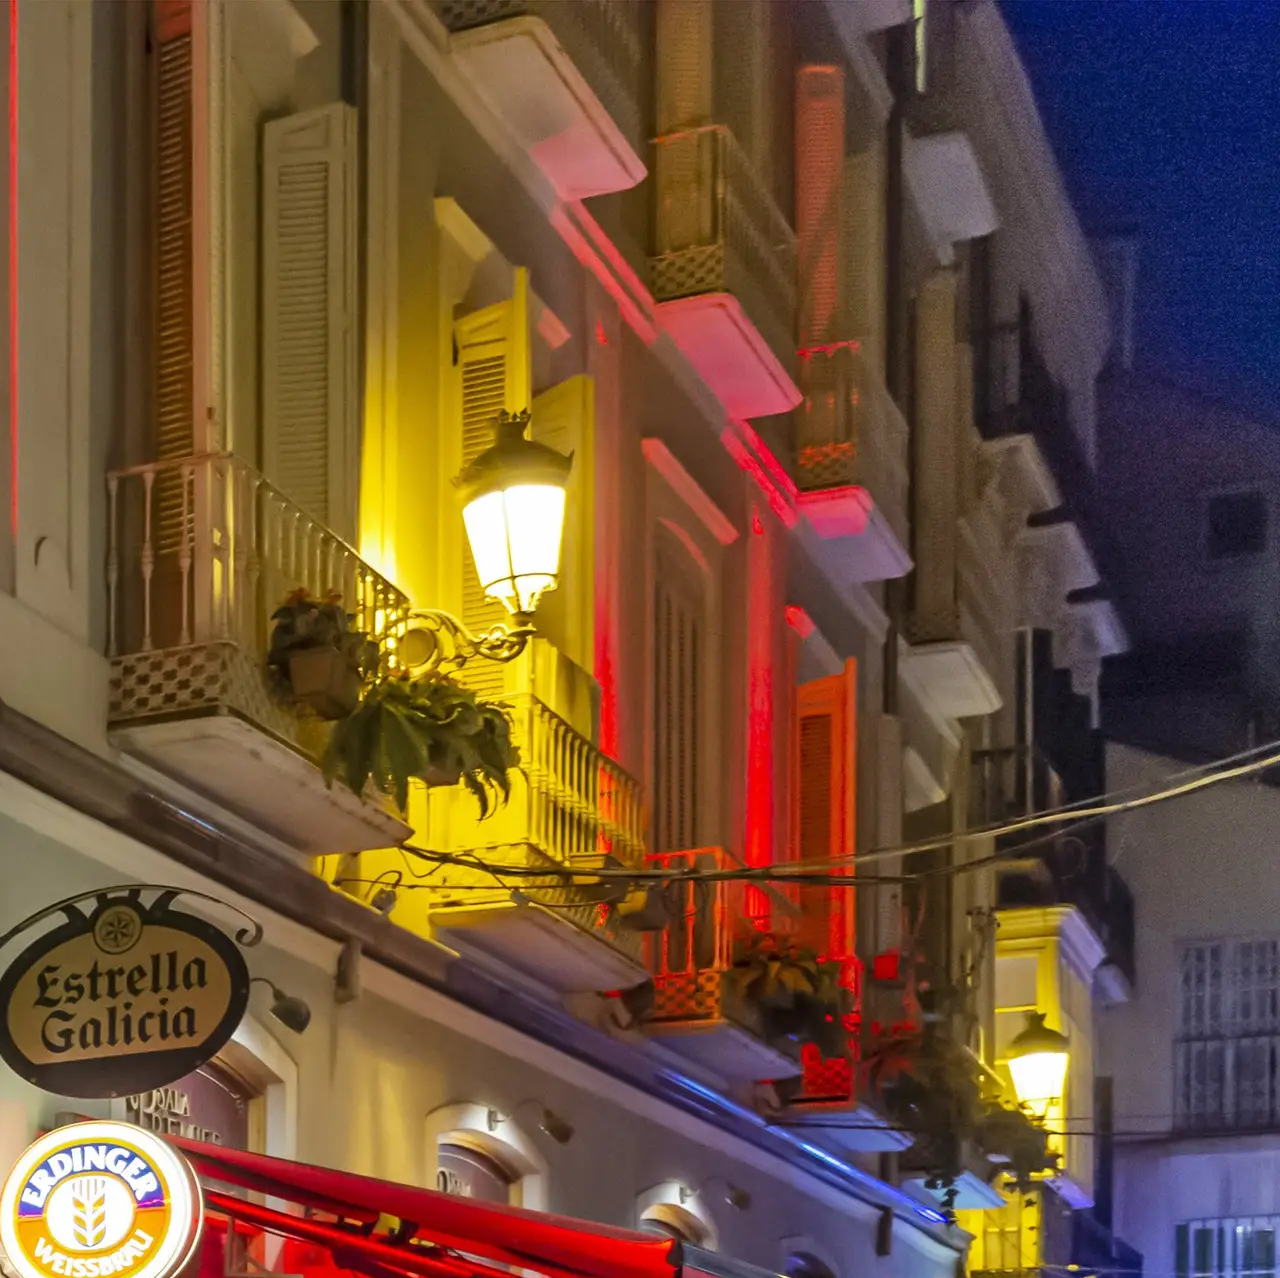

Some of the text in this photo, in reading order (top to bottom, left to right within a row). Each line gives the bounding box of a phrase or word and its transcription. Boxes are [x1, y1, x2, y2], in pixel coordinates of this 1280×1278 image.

[33, 951, 207, 1008] Estrella
[41, 998, 200, 1053] Galicia
[21, 1145, 159, 1208] ERDINGER
